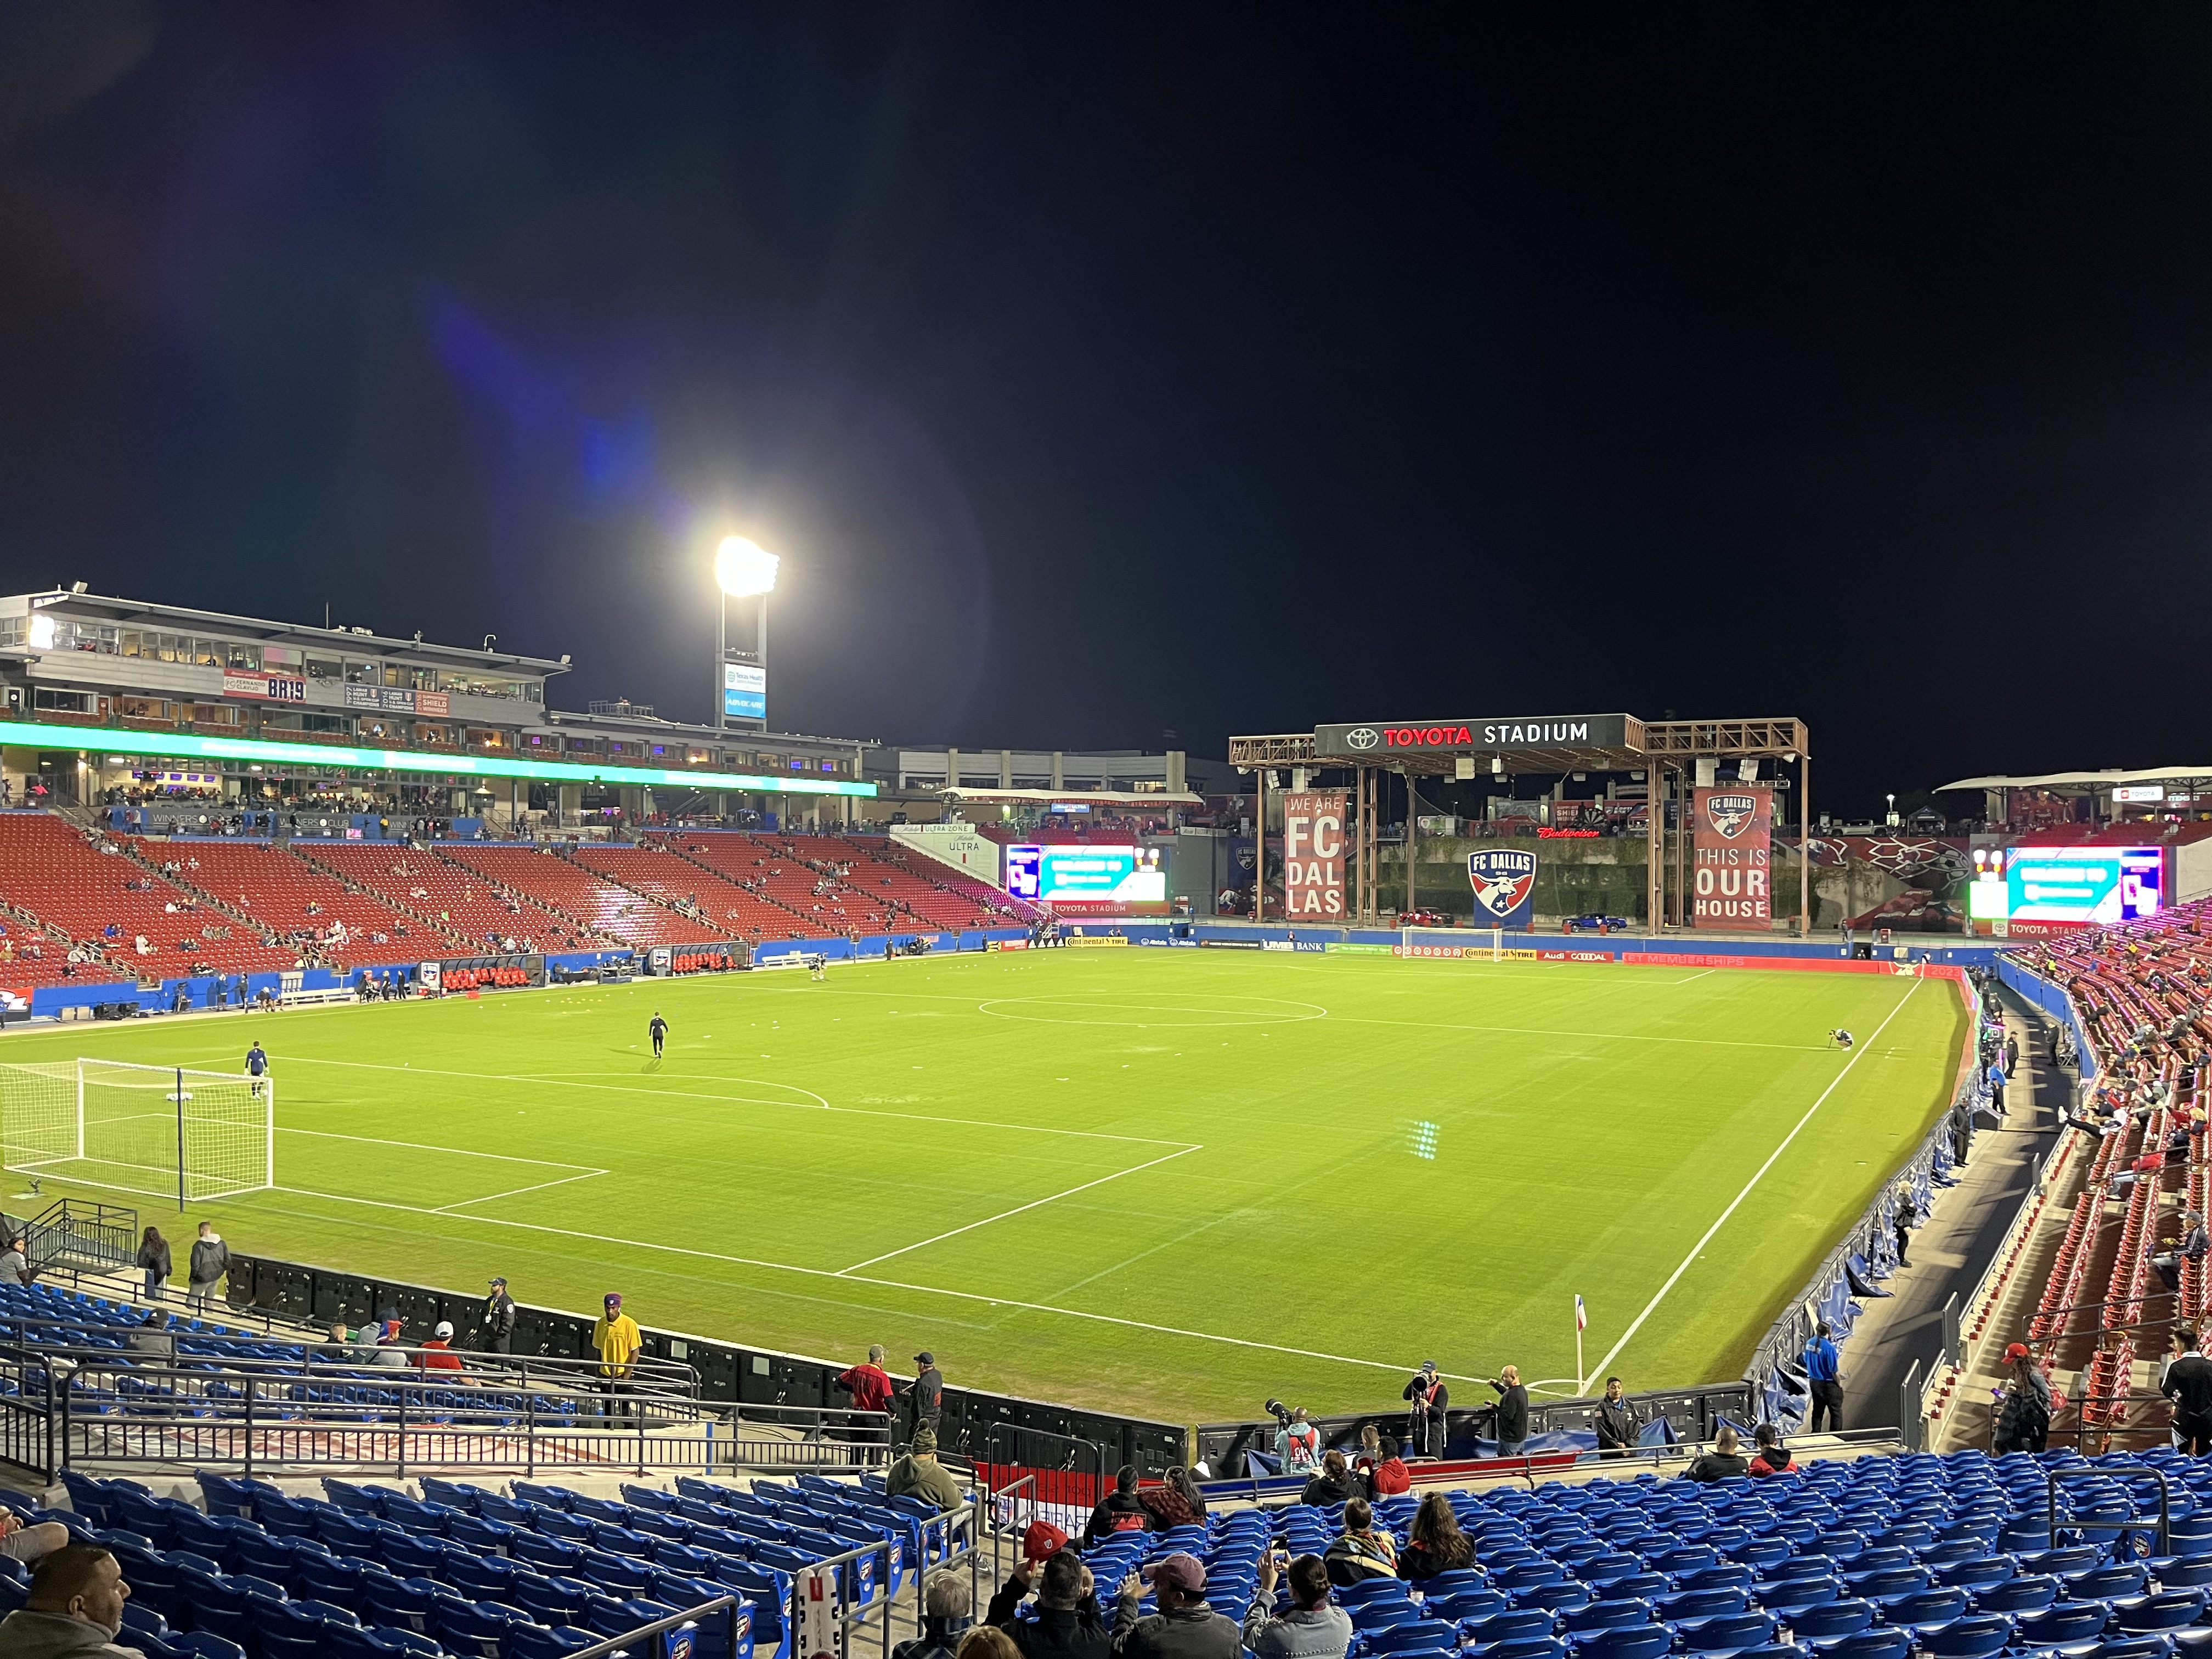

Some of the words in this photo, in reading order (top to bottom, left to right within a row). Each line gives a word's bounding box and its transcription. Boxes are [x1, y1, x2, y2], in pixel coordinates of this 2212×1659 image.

[727, 699, 764, 708] ADVOCARE
[1383, 726, 1472, 746] TOYOTA
[1484, 723, 1588, 743] STADIUM
[1291, 798, 1311, 810] WE
[1315, 797, 1340, 810] ARE
[1711, 799, 1720, 809] FC
[1723, 798, 1752, 809] DALLAS
[328, 819, 349, 827] CLUB
[1288, 816, 1340, 858] FC
[1537, 827, 1600, 838] Budweiser
[1474, 855, 1486, 871] FC
[1491, 854, 1530, 871] DALLAS
[1697, 849, 1739, 865] THIS
[1749, 849, 1765, 866] IS
[1288, 862, 1340, 885] DAL
[1696, 868, 1765, 896] OUR
[1288, 889, 1340, 913] LAS
[1696, 900, 1765, 917] HOUSE
[2011, 924, 2048, 934] TOYOTA
[1263, 940, 1294, 949] UMB
[1297, 942, 1322, 951] BANK
[1648, 955, 1745, 966] MEMBERSHIPS
[1931, 967, 1961, 977] 2023
